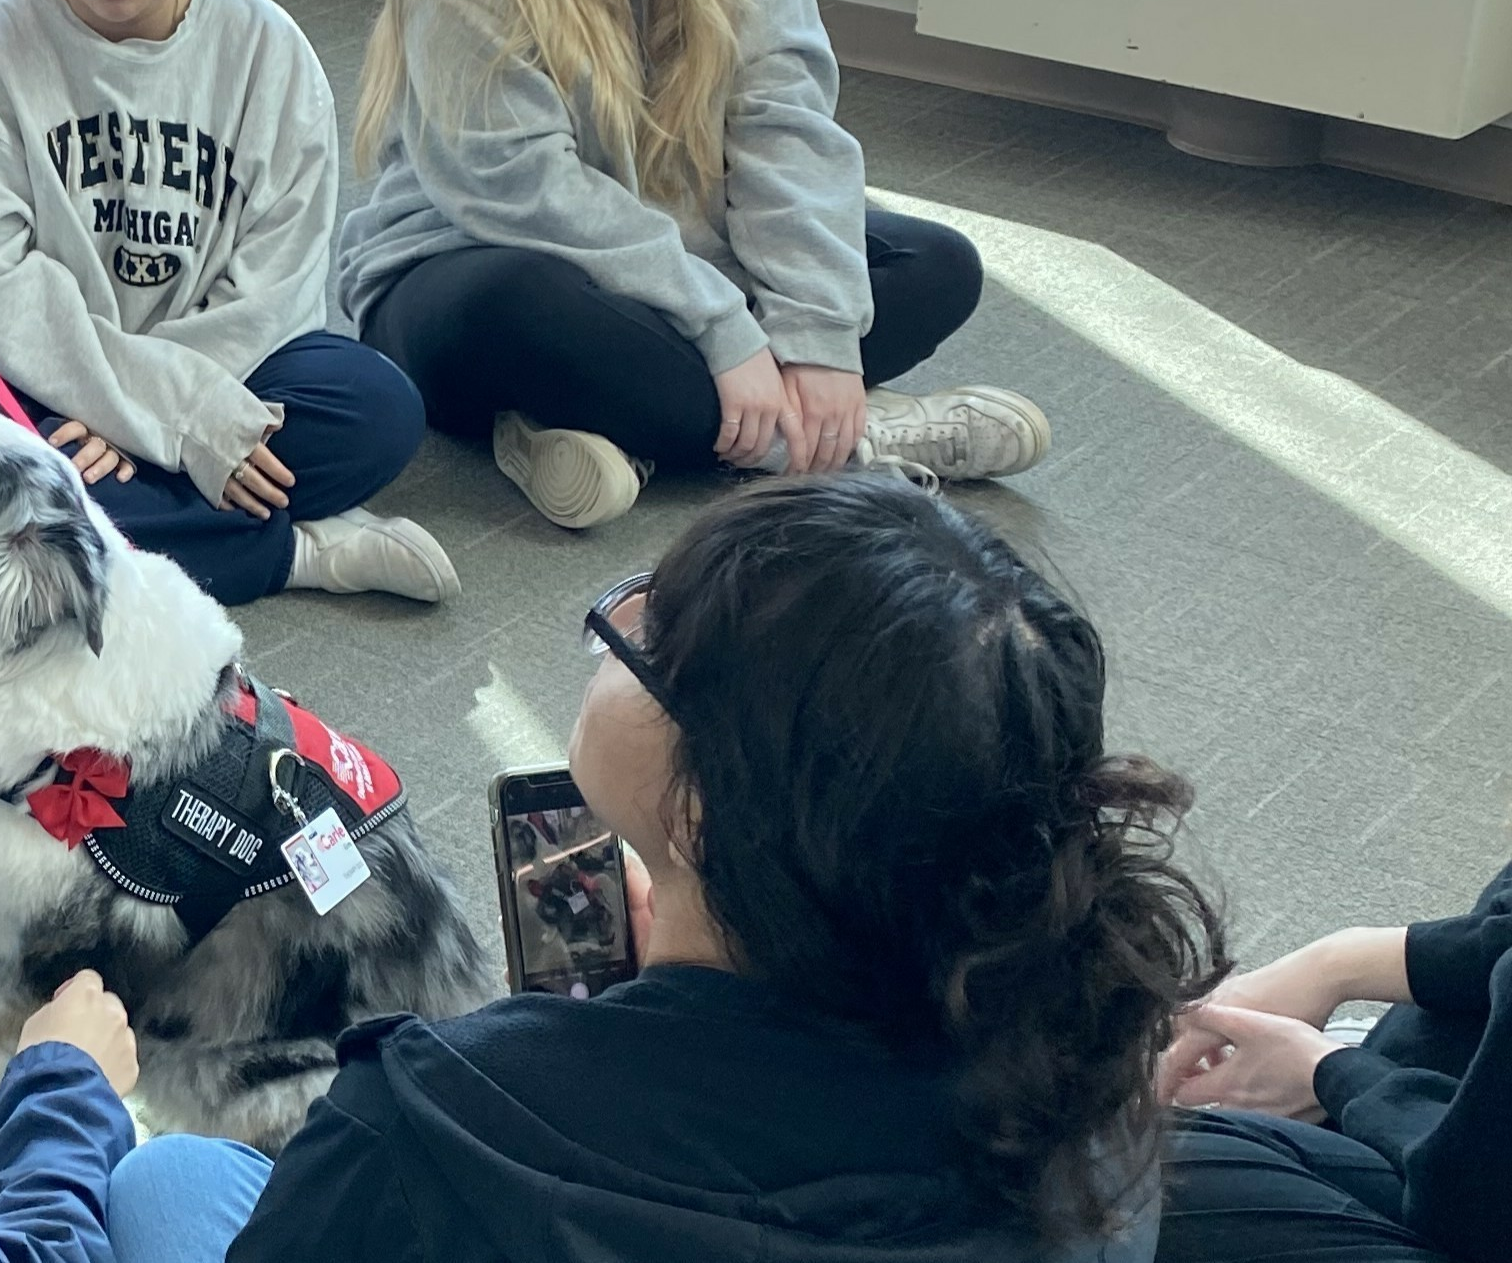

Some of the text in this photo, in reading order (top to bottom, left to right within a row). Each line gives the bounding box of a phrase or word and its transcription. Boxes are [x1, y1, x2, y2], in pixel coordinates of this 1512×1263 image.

[92, 198, 200, 247] MIHIGA
[171, 788, 264, 866] THERAPY DOG
